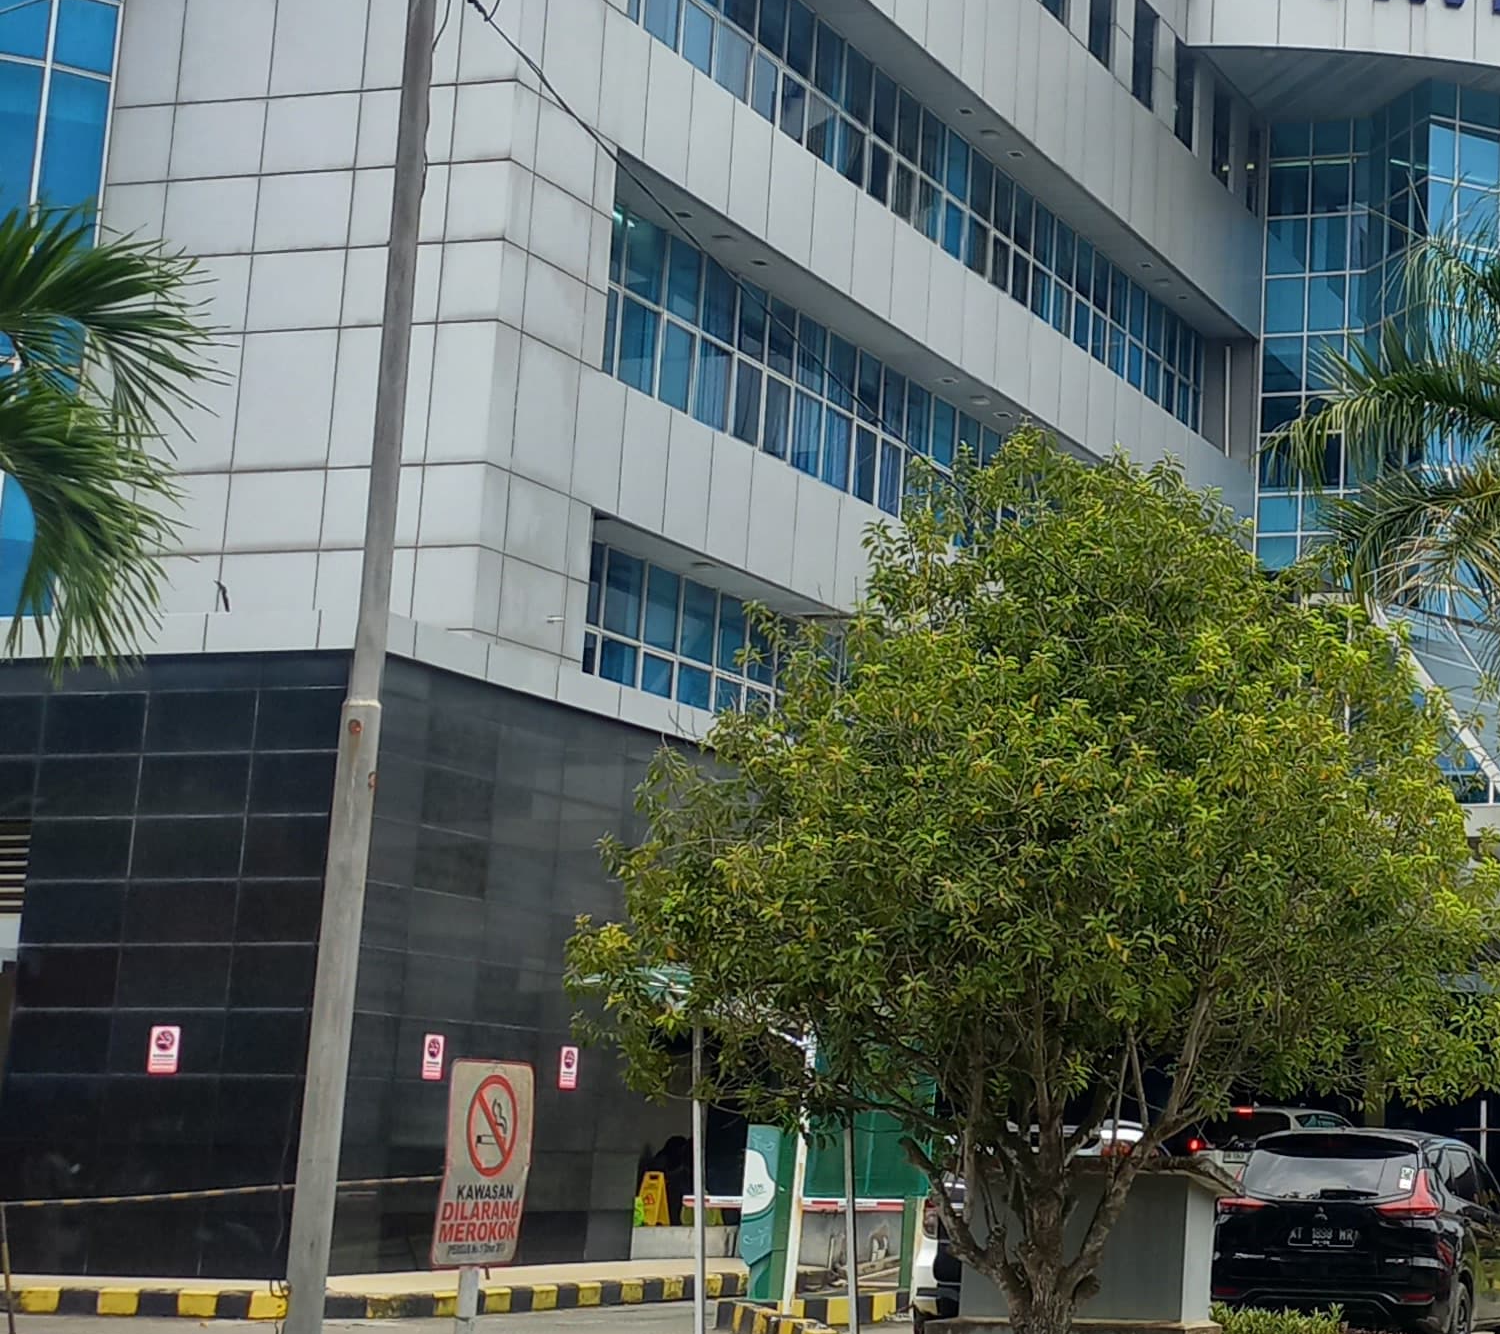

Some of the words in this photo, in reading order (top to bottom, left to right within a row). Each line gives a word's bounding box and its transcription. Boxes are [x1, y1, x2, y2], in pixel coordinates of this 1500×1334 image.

[456, 1184, 514, 1200] KAWASAN
[441, 1199, 520, 1221] DILARANG
[439, 1220, 517, 1243] MEROKOK
